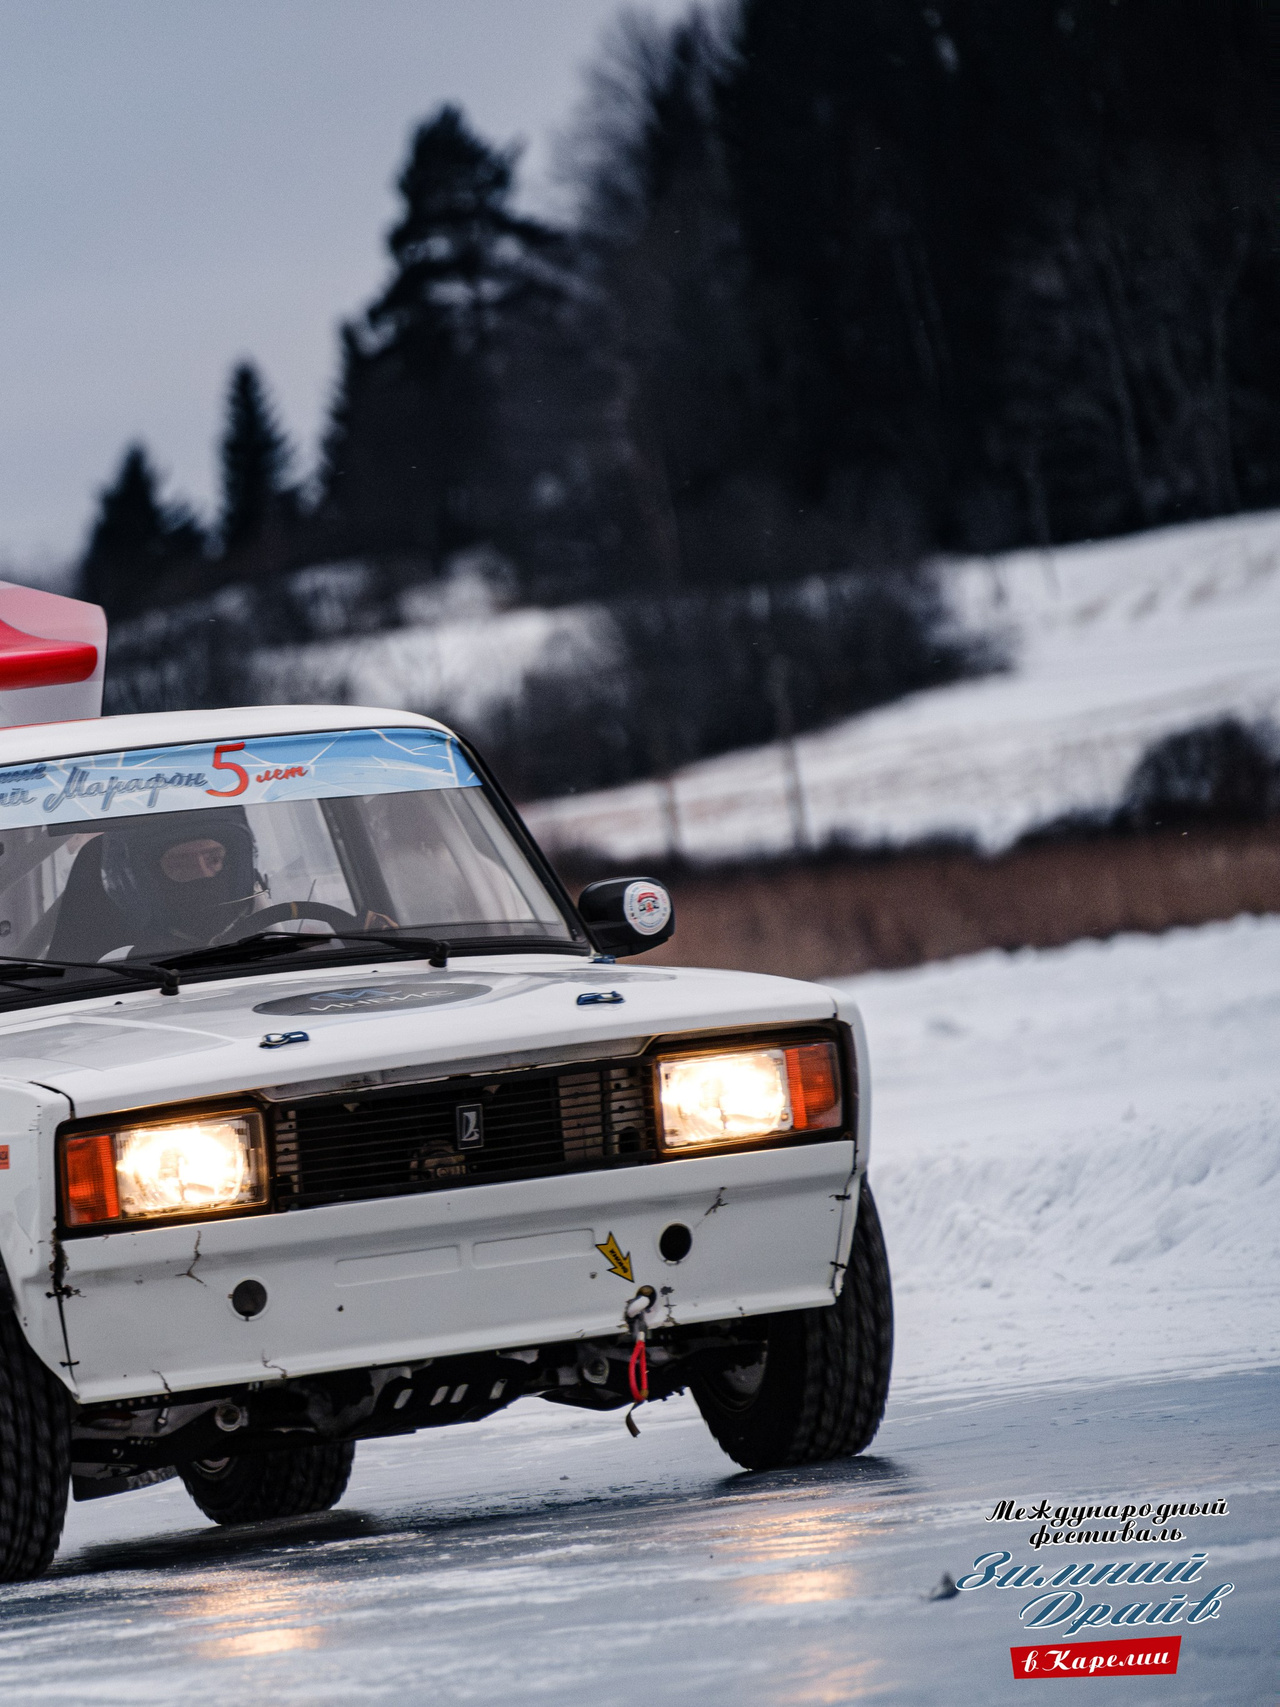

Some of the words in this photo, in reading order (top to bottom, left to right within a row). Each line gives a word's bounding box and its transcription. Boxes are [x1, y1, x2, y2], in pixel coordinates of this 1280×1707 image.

[43, 765, 208, 812] Марафон
[205, 742, 249, 798] 5
[255, 765, 309, 783] лет
